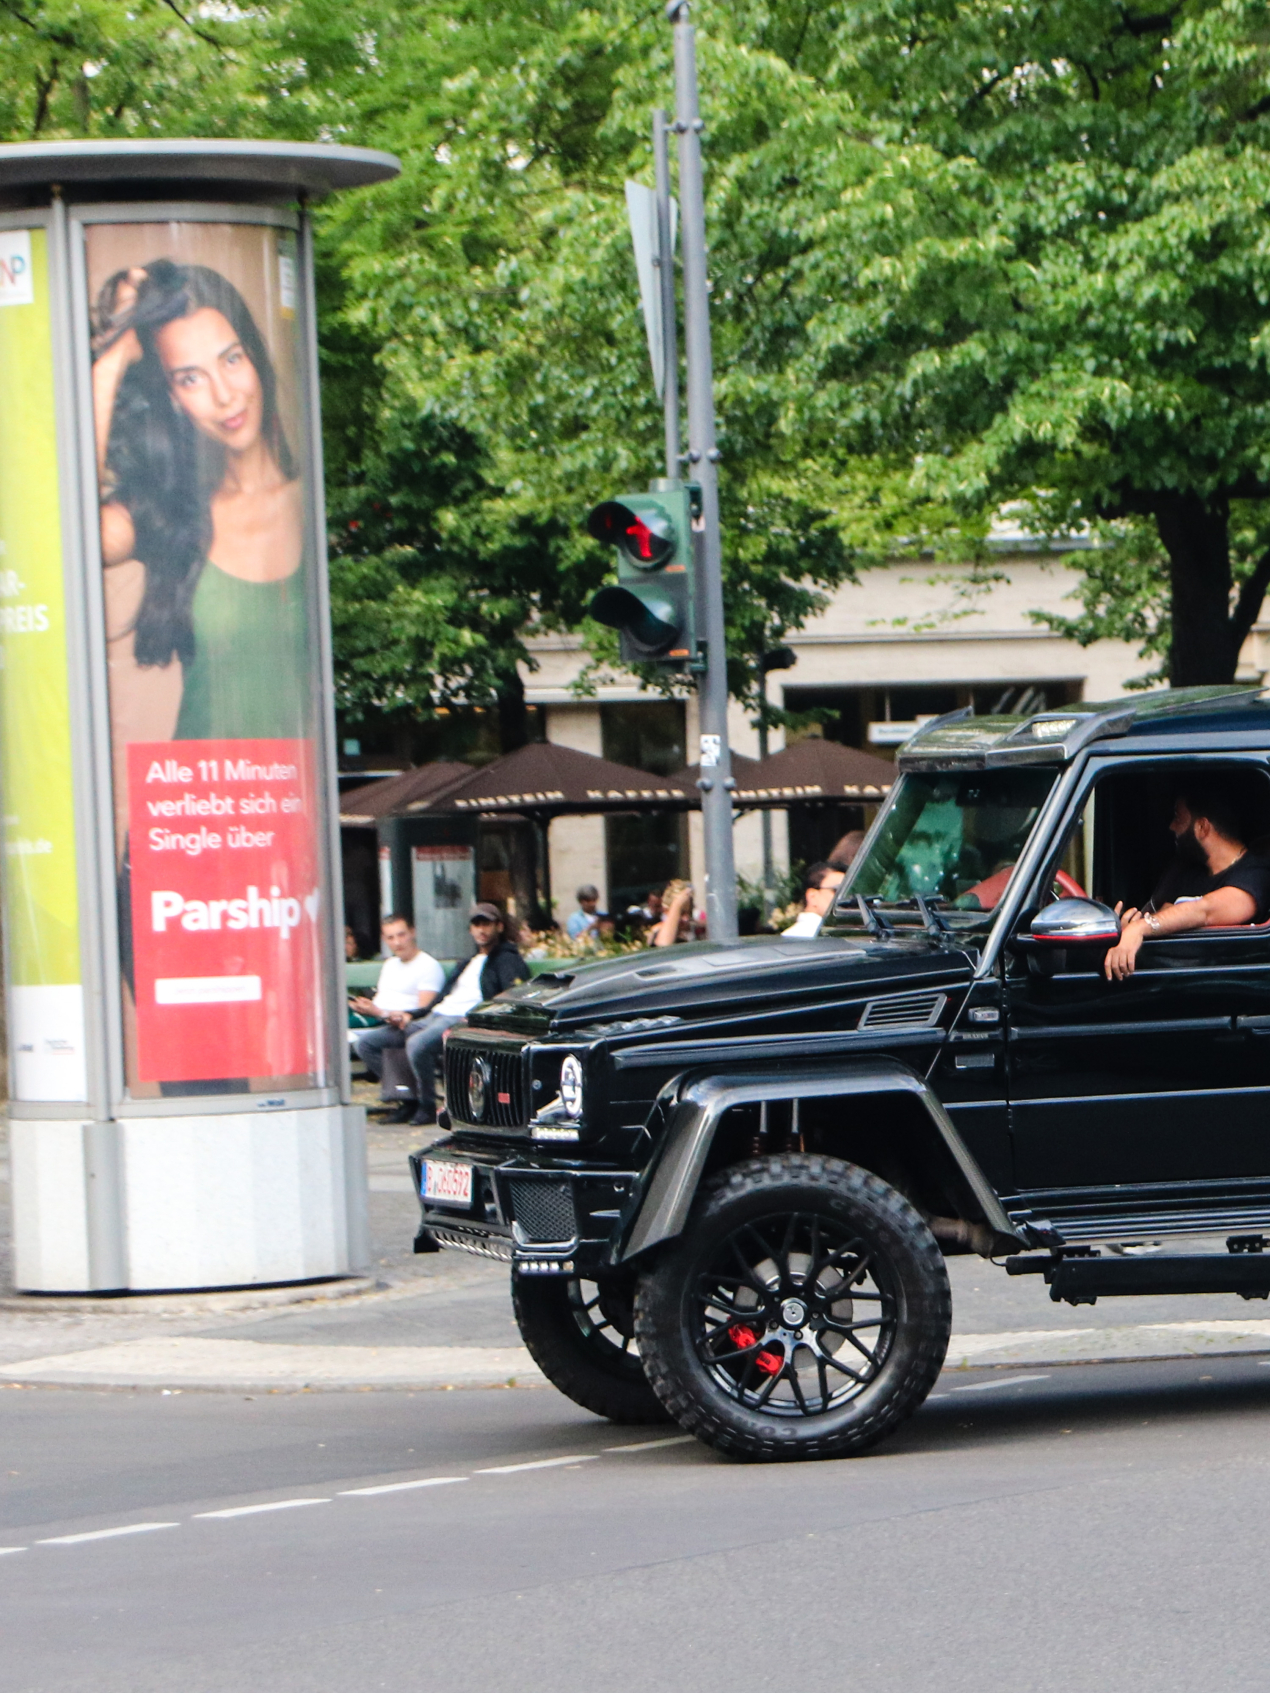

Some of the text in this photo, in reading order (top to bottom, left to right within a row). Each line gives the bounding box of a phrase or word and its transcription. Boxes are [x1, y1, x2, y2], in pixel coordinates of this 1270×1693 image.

[146, 759, 297, 783] Alle 11 Minuten
[147, 792, 235, 816] verliebt
[239, 792, 277, 814] sich
[454, 790, 565, 808] EINSTEIN
[149, 825, 275, 855] Single über
[151, 885, 300, 939] Parship
